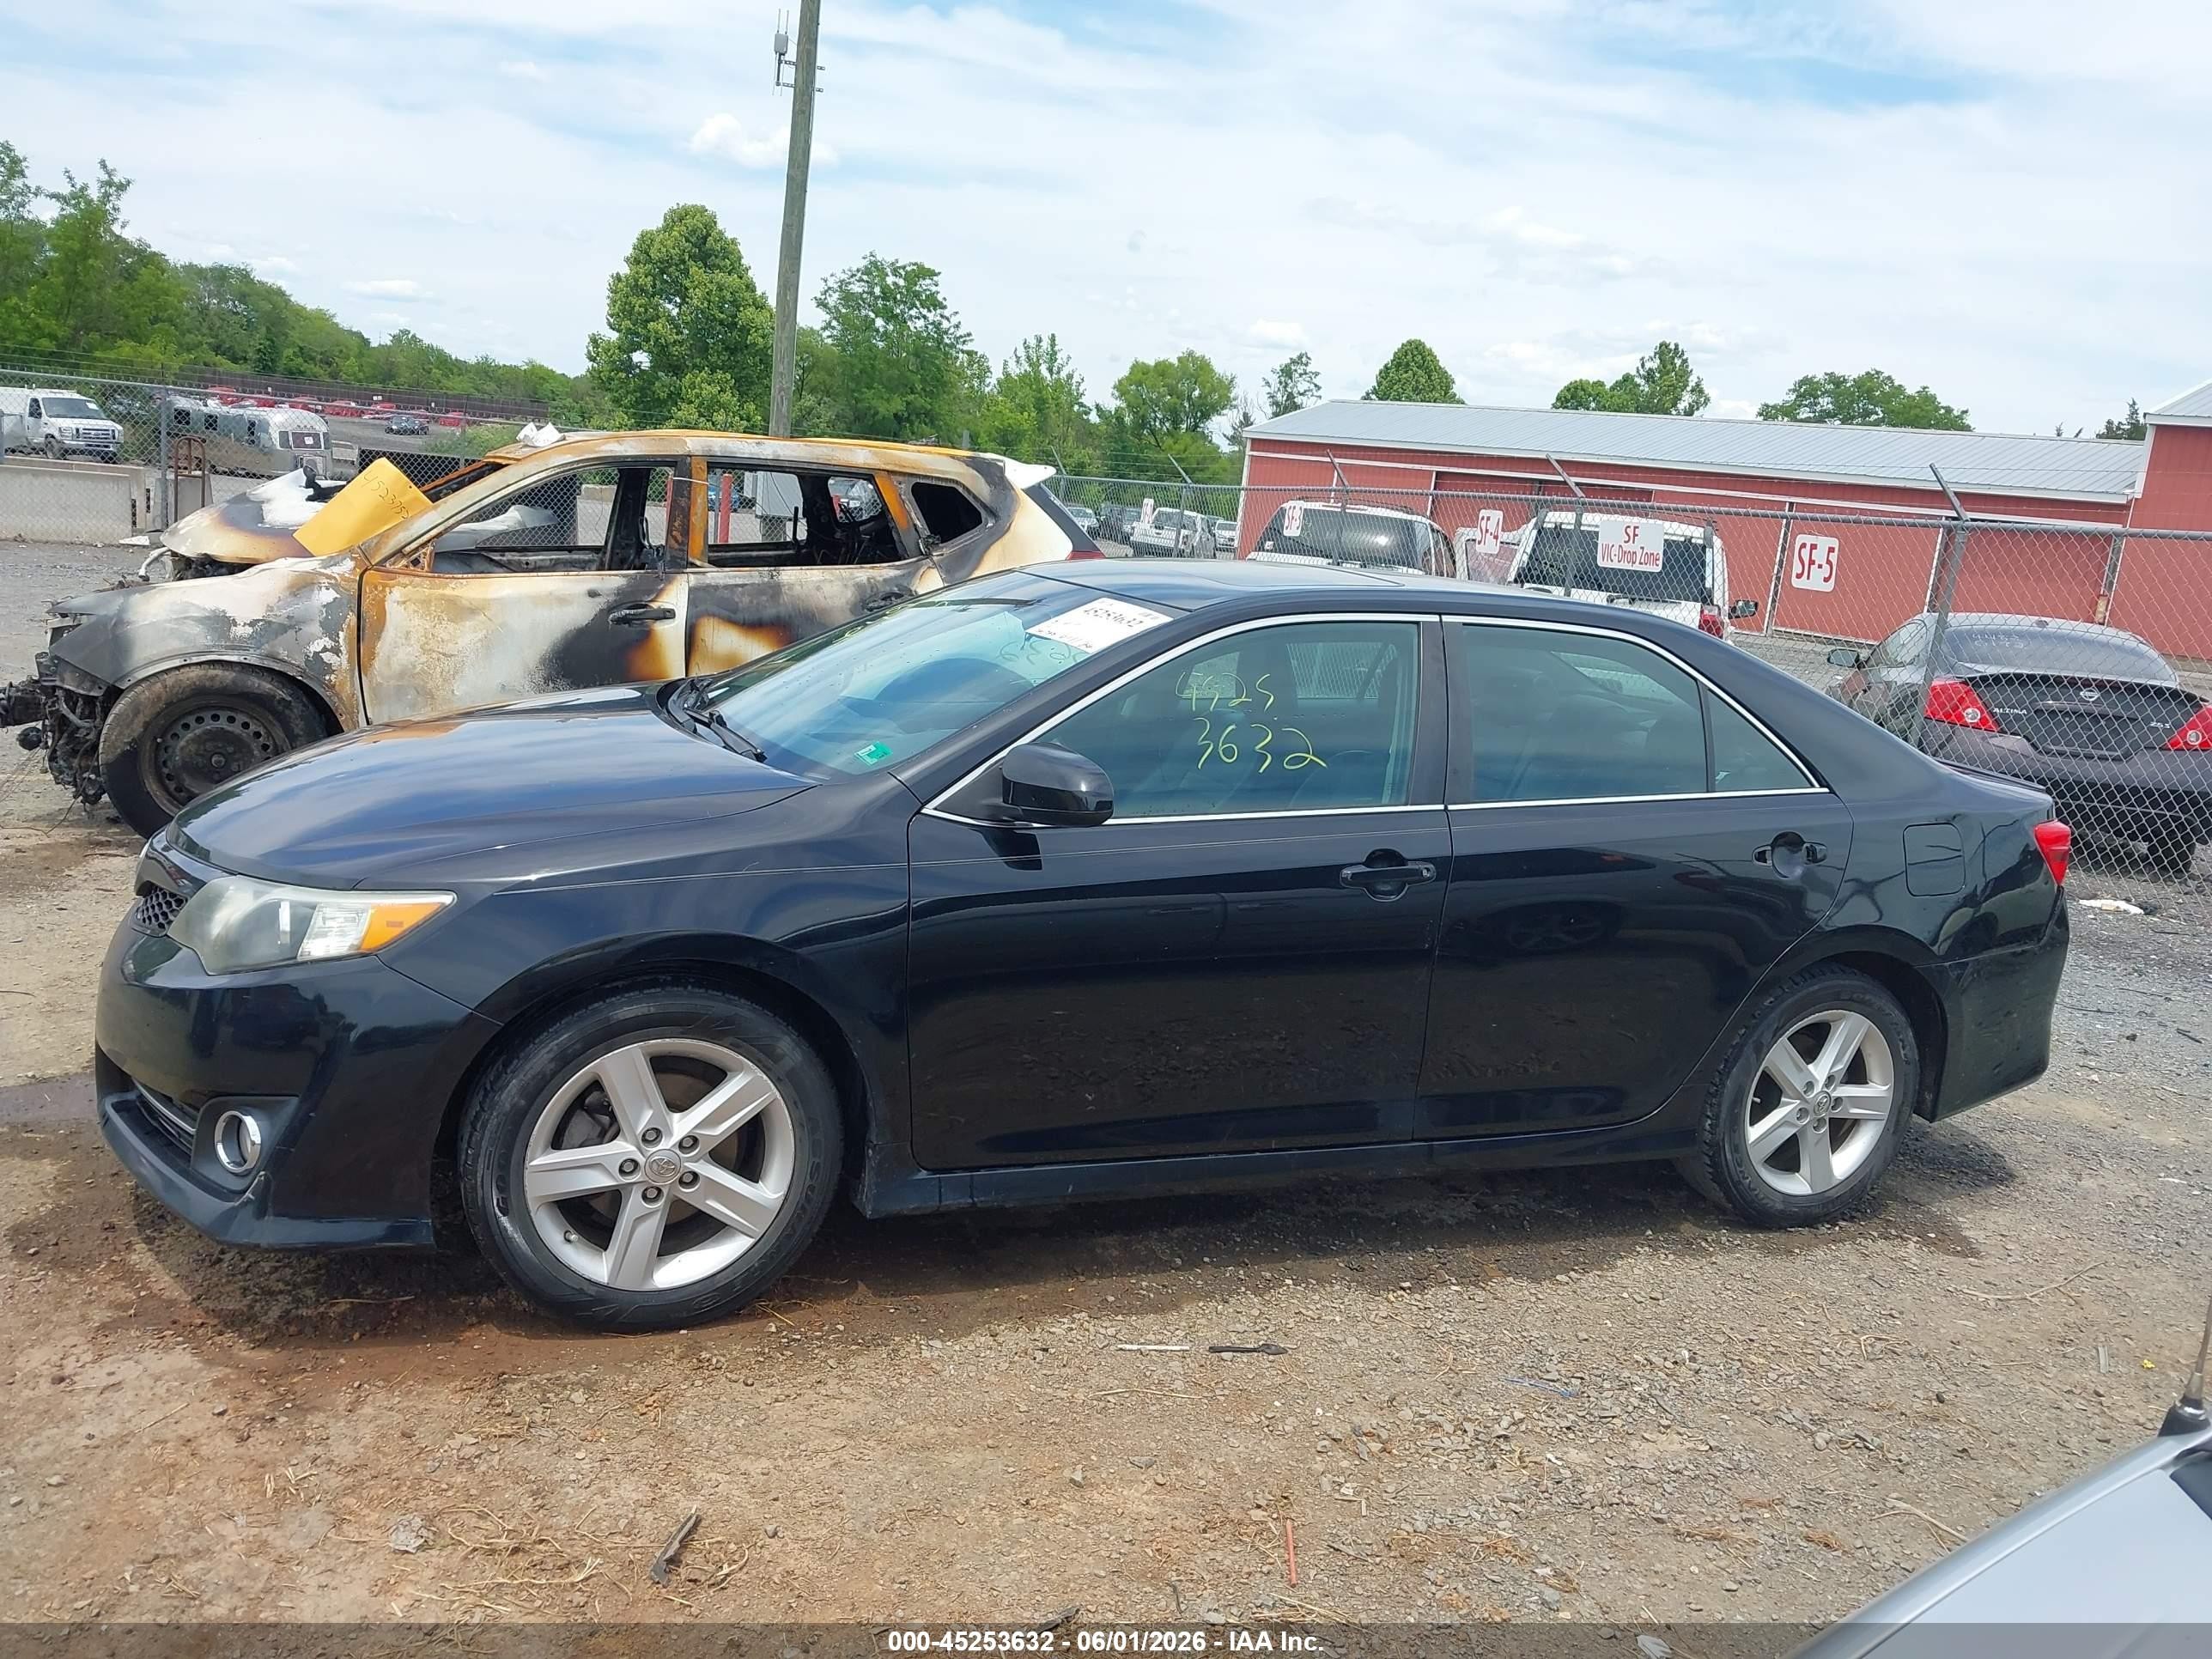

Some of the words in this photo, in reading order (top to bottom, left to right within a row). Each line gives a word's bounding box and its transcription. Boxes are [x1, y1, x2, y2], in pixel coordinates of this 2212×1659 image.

[1285, 504, 1303, 531] SF-3
[1478, 515, 1500, 546] SF-4
[1624, 525, 1639, 544] SF
[1601, 543, 1638, 564] VIC-Drop
[1639, 546, 1661, 568] Zone
[1796, 542, 1835, 583] SF-5
[1176, 672, 1274, 712] 4525
[1993, 707, 2027, 715] ALTIMA
[1193, 717, 1328, 773] 3632
